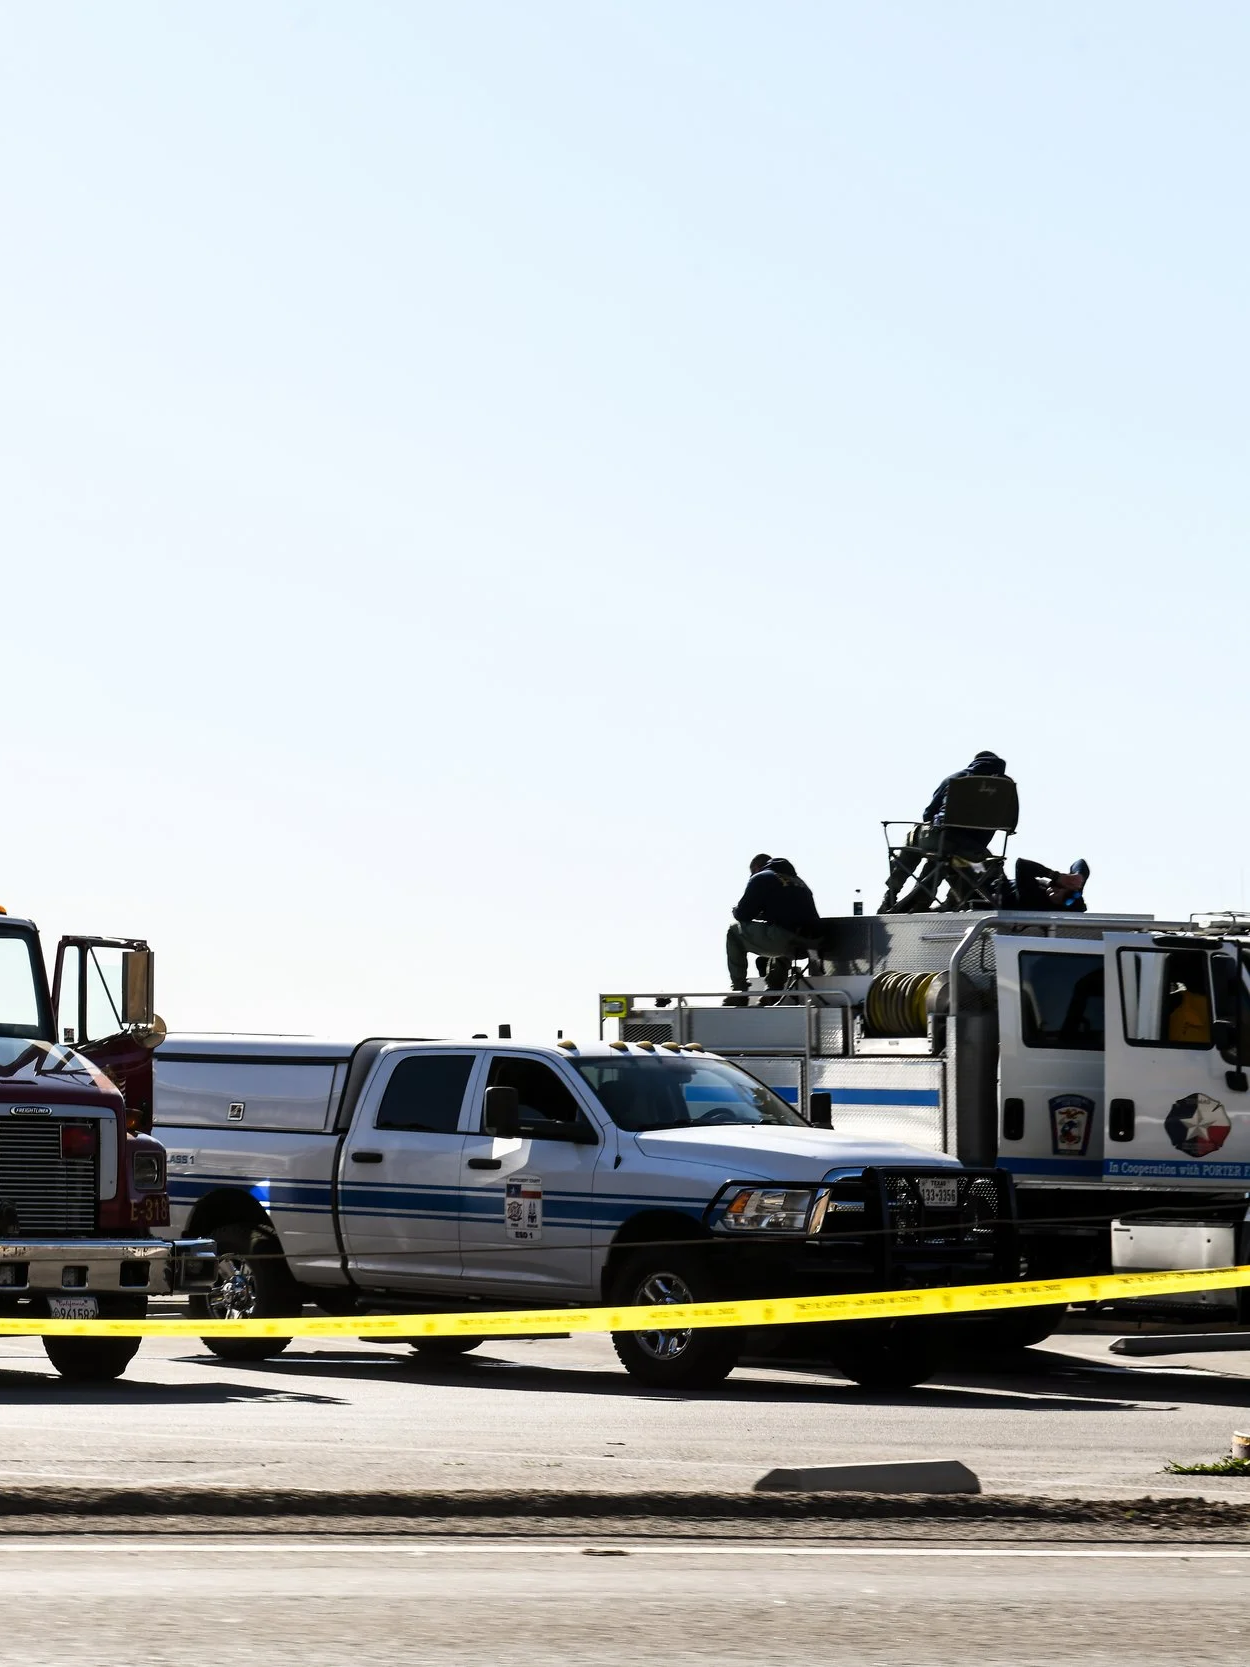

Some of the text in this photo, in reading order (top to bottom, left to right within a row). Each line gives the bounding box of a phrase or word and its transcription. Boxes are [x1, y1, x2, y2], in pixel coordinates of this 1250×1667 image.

[1109, 1162, 1118, 1173] In
[1121, 1162, 1177, 1176] Cooperation
[1180, 1163, 1200, 1175] with
[1202, 1164, 1241, 1177] PORTER
[131, 1197, 168, 1221] E-318
